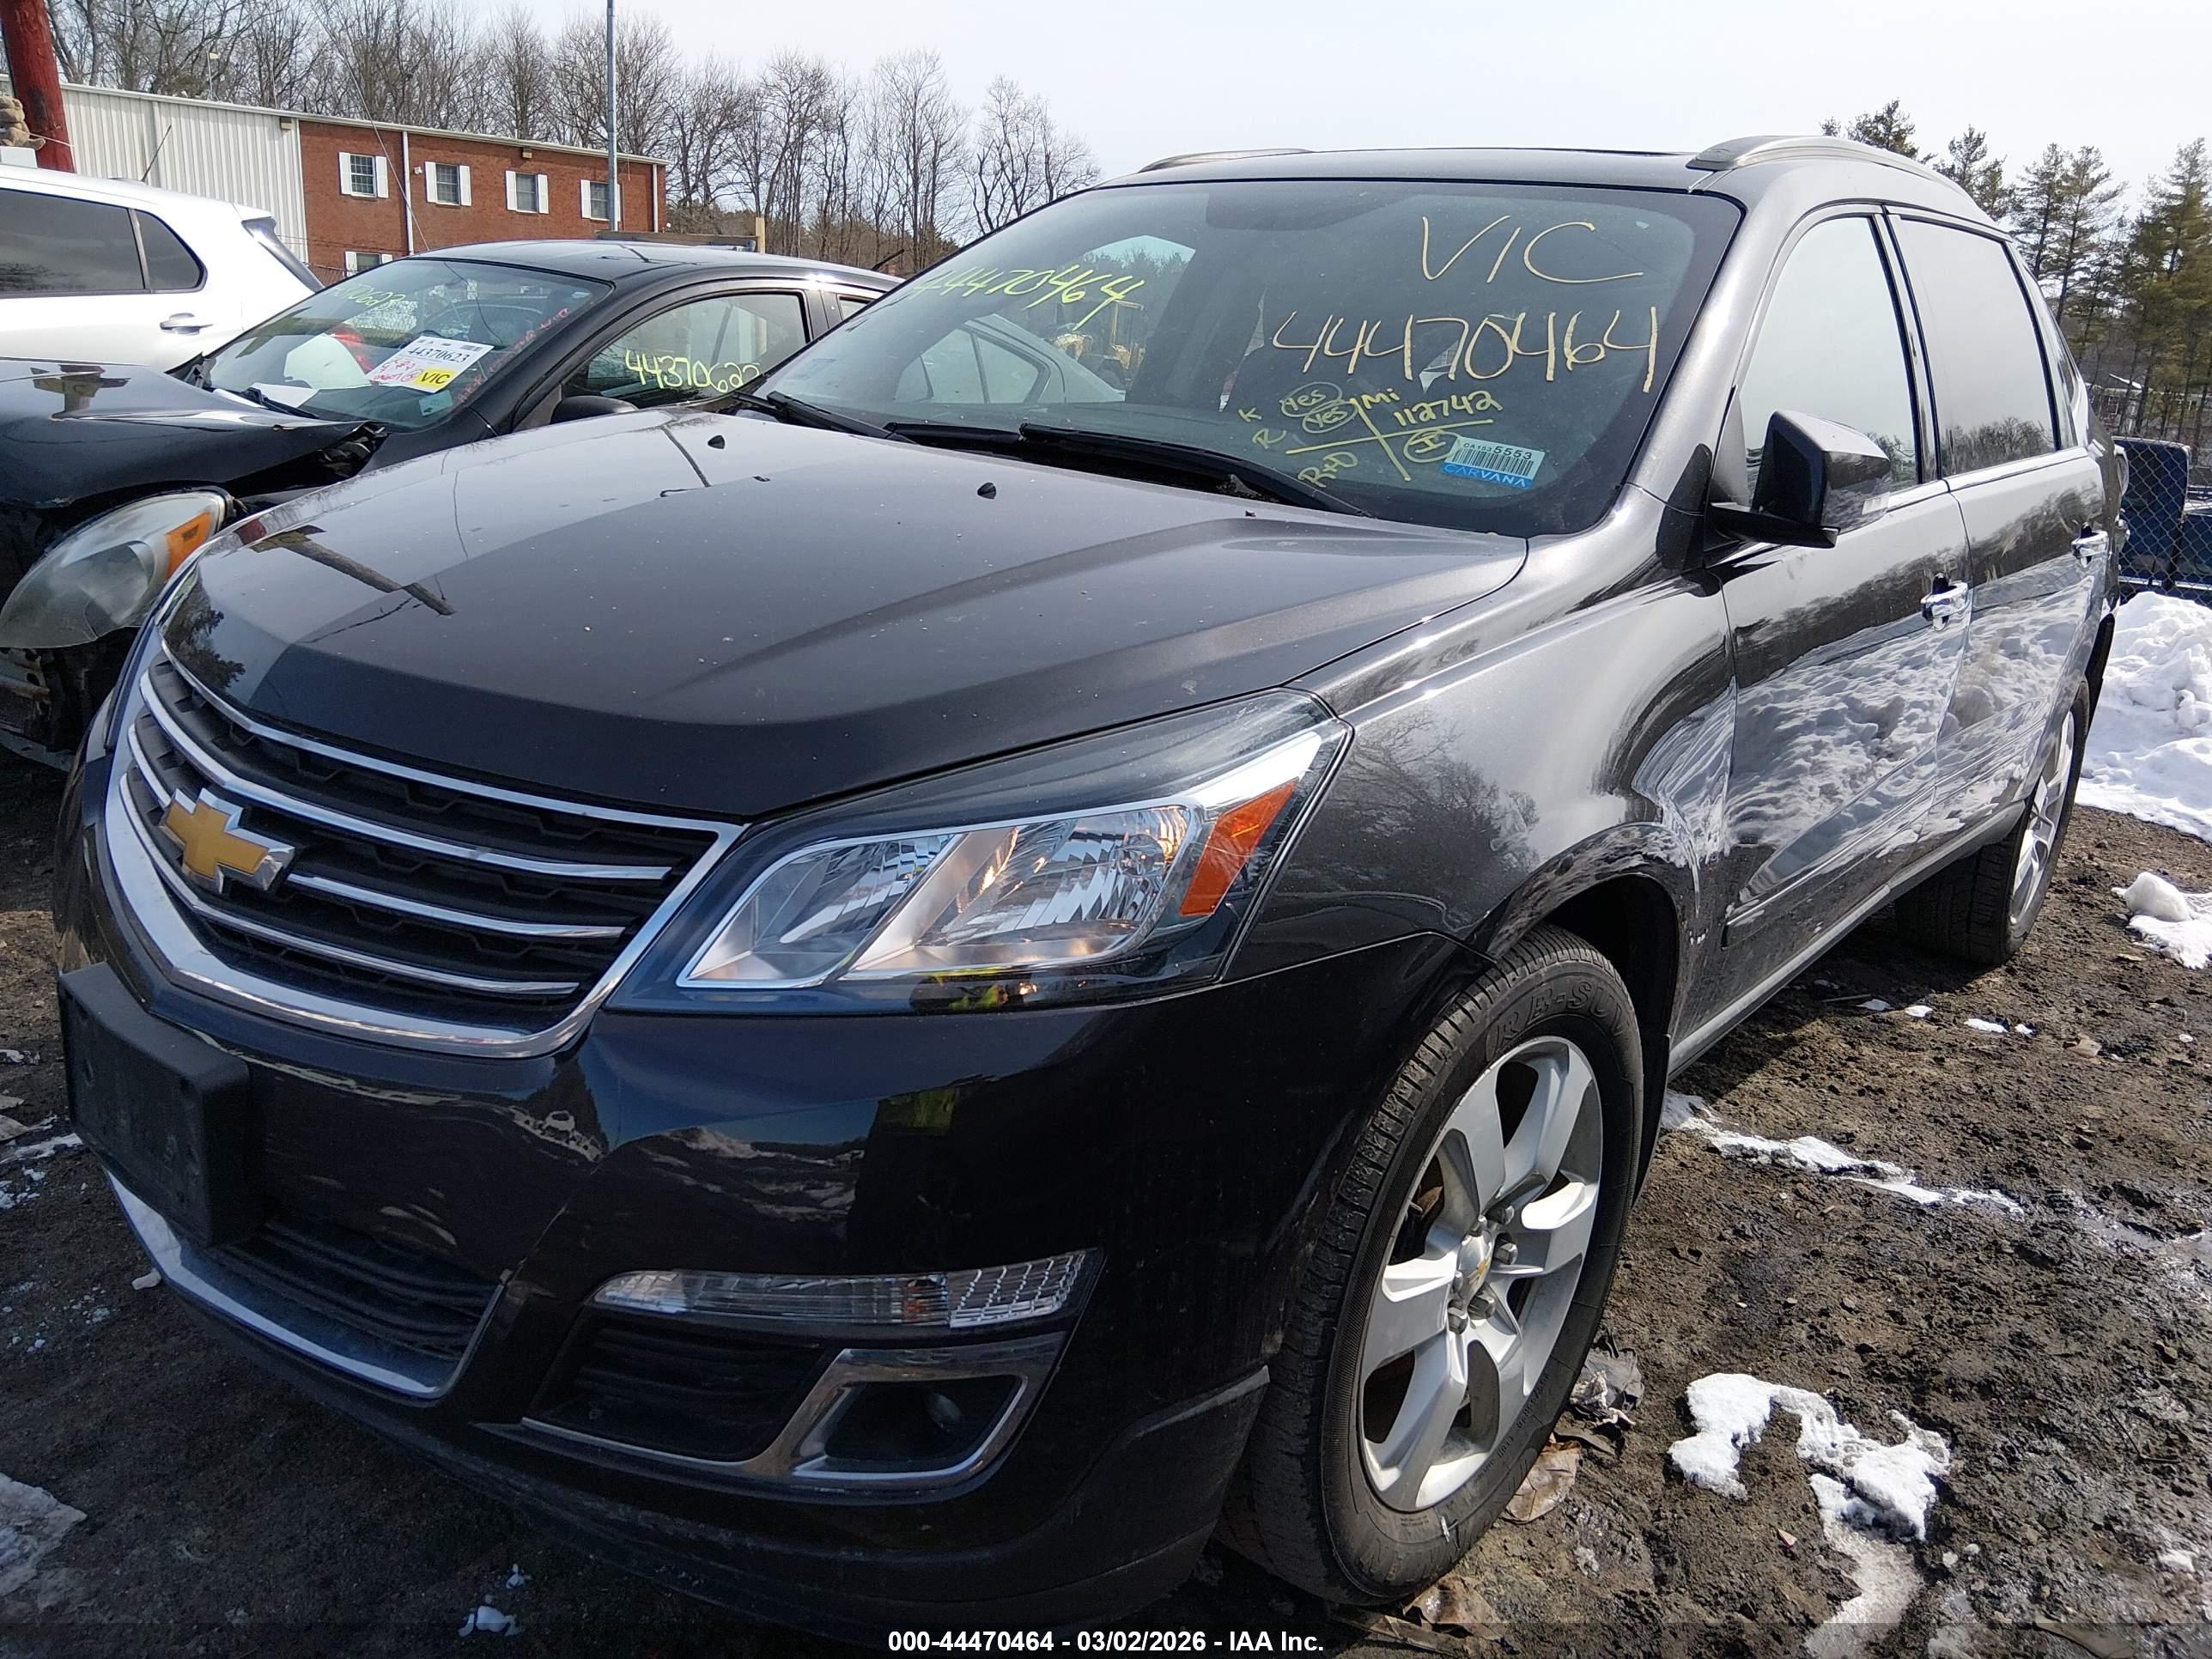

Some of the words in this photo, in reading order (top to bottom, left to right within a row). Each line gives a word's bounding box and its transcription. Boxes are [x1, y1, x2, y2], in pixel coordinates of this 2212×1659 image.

[1421, 215, 1644, 283] VIC
[912, 264, 1145, 331] 44470464
[408, 346, 471, 363] 44370623
[1272, 306, 1657, 393] 44470464
[421, 372, 450, 385] VIC
[1394, 391, 1504, 427] 112742
[1443, 464, 1527, 488] CARVANA
